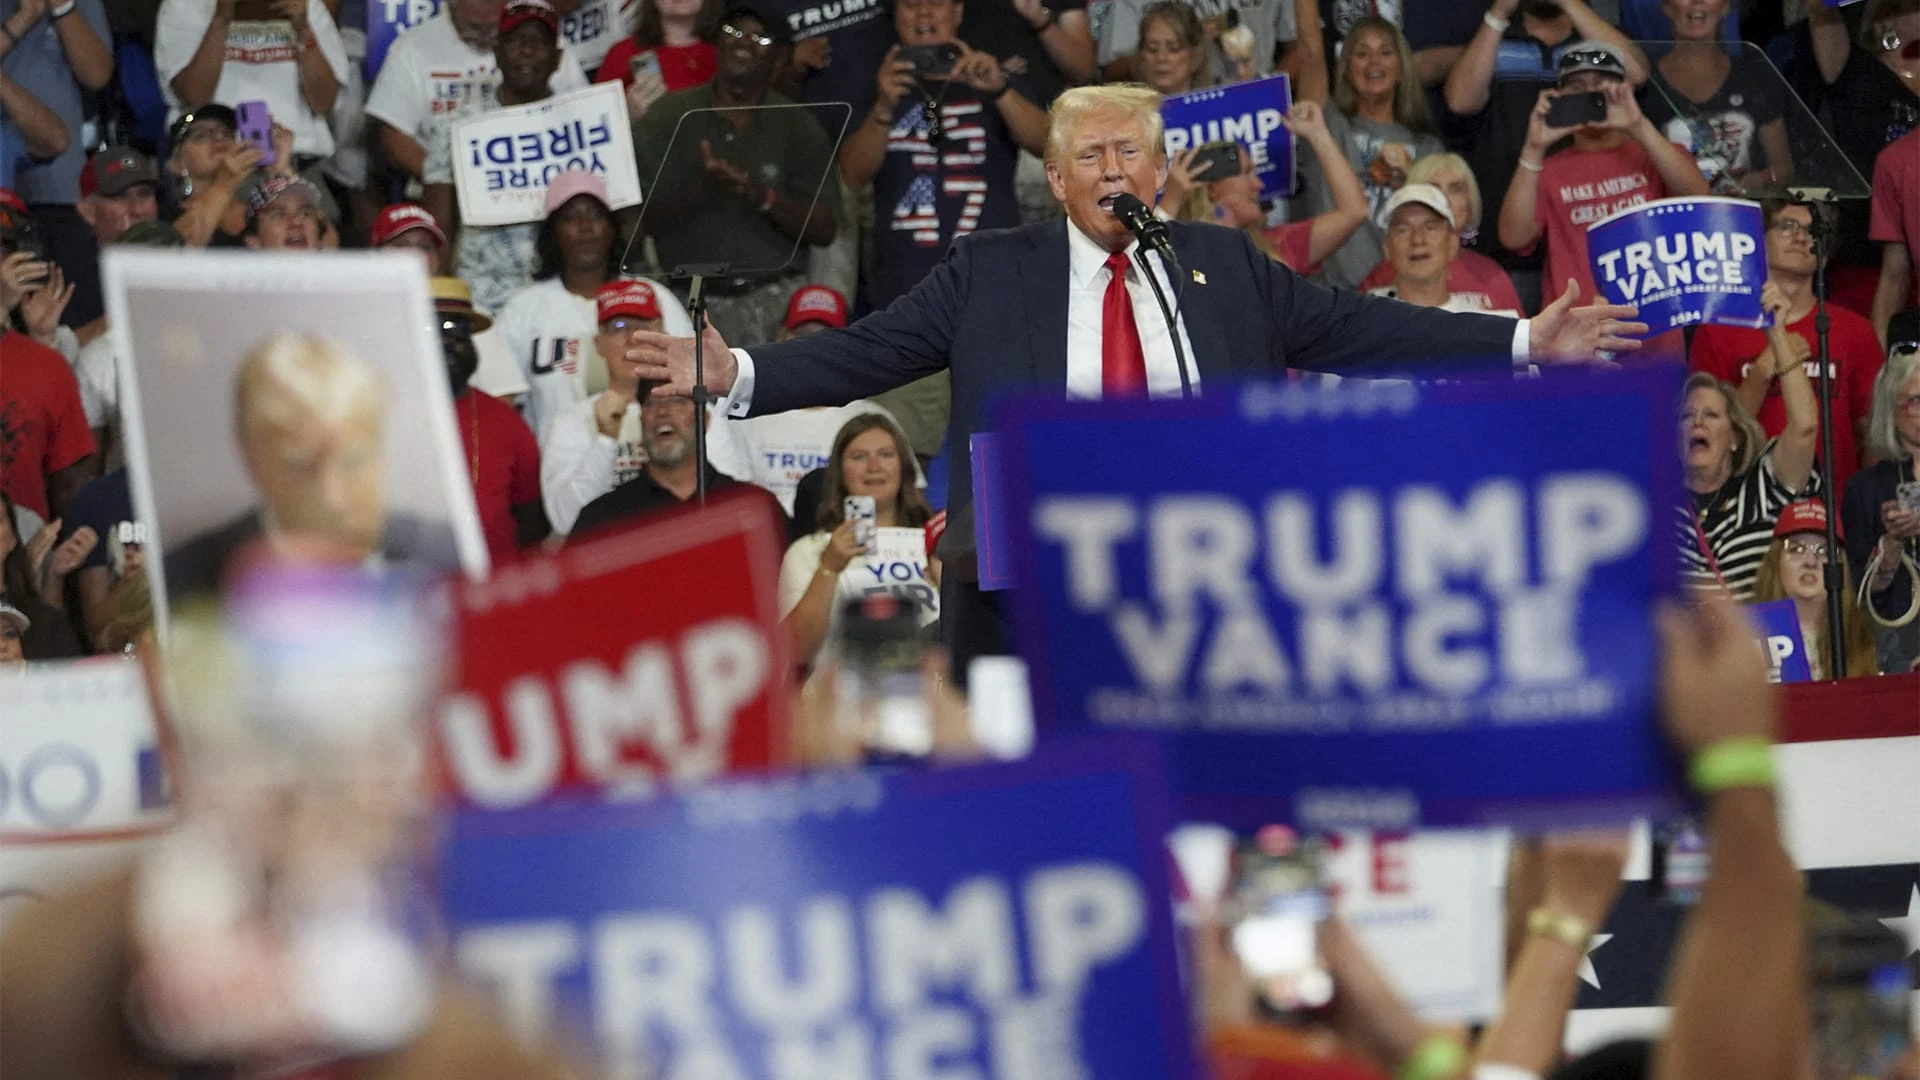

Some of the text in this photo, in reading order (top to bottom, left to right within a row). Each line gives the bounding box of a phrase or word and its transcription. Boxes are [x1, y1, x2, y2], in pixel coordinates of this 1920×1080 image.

[470, 119, 612, 167] FIRED!
[887, 101, 987, 170] 45
[891, 175, 988, 247] 47
[1560, 172, 1649, 204] MAKE AMERICA
[1597, 231, 1756, 283] TRUMP
[1616, 260, 1744, 301] VANCE
[1670, 309, 1702, 327] 2024
[1033, 470, 1650, 612] TRUMP
[1106, 593, 1588, 697] VANCE
[454, 860, 1146, 1044] TRUMP
